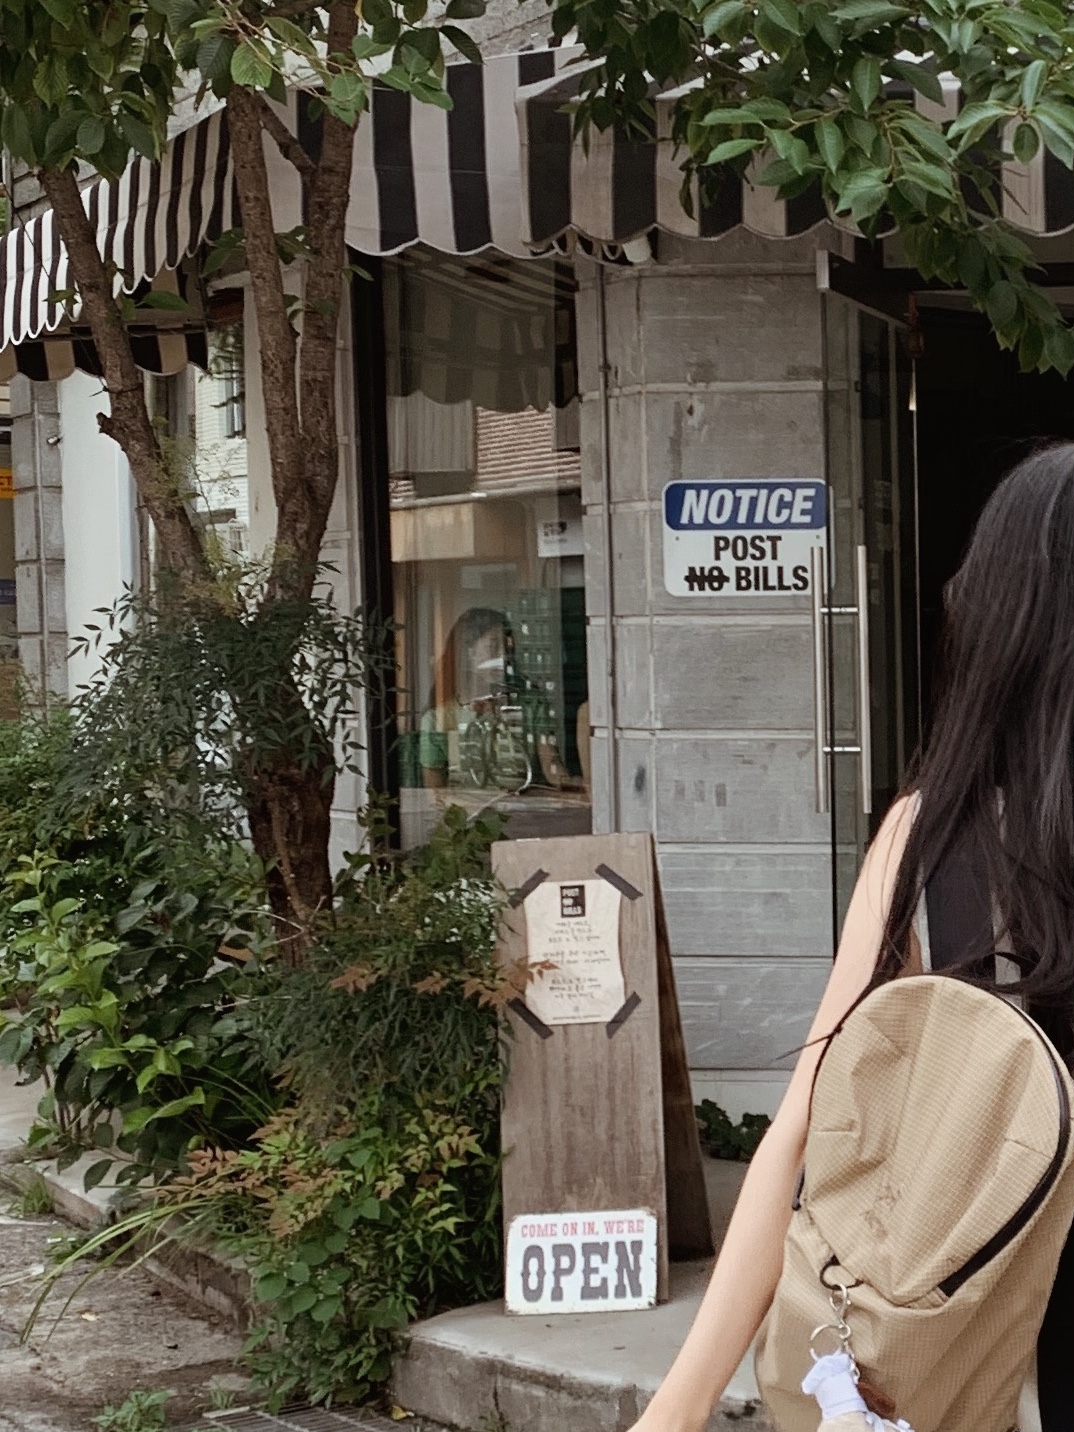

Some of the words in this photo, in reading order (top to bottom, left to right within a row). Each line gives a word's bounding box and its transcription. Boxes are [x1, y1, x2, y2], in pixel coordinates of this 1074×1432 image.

[680, 488, 816, 524] NOTICE
[714, 535, 782, 561] POST
[735, 566, 809, 591] BILLS
[521, 1223, 558, 1238] COME
[562, 1221, 578, 1236] ON
[603, 1219, 645, 1234] WE'RE
[521, 1240, 643, 1303] OPEN
